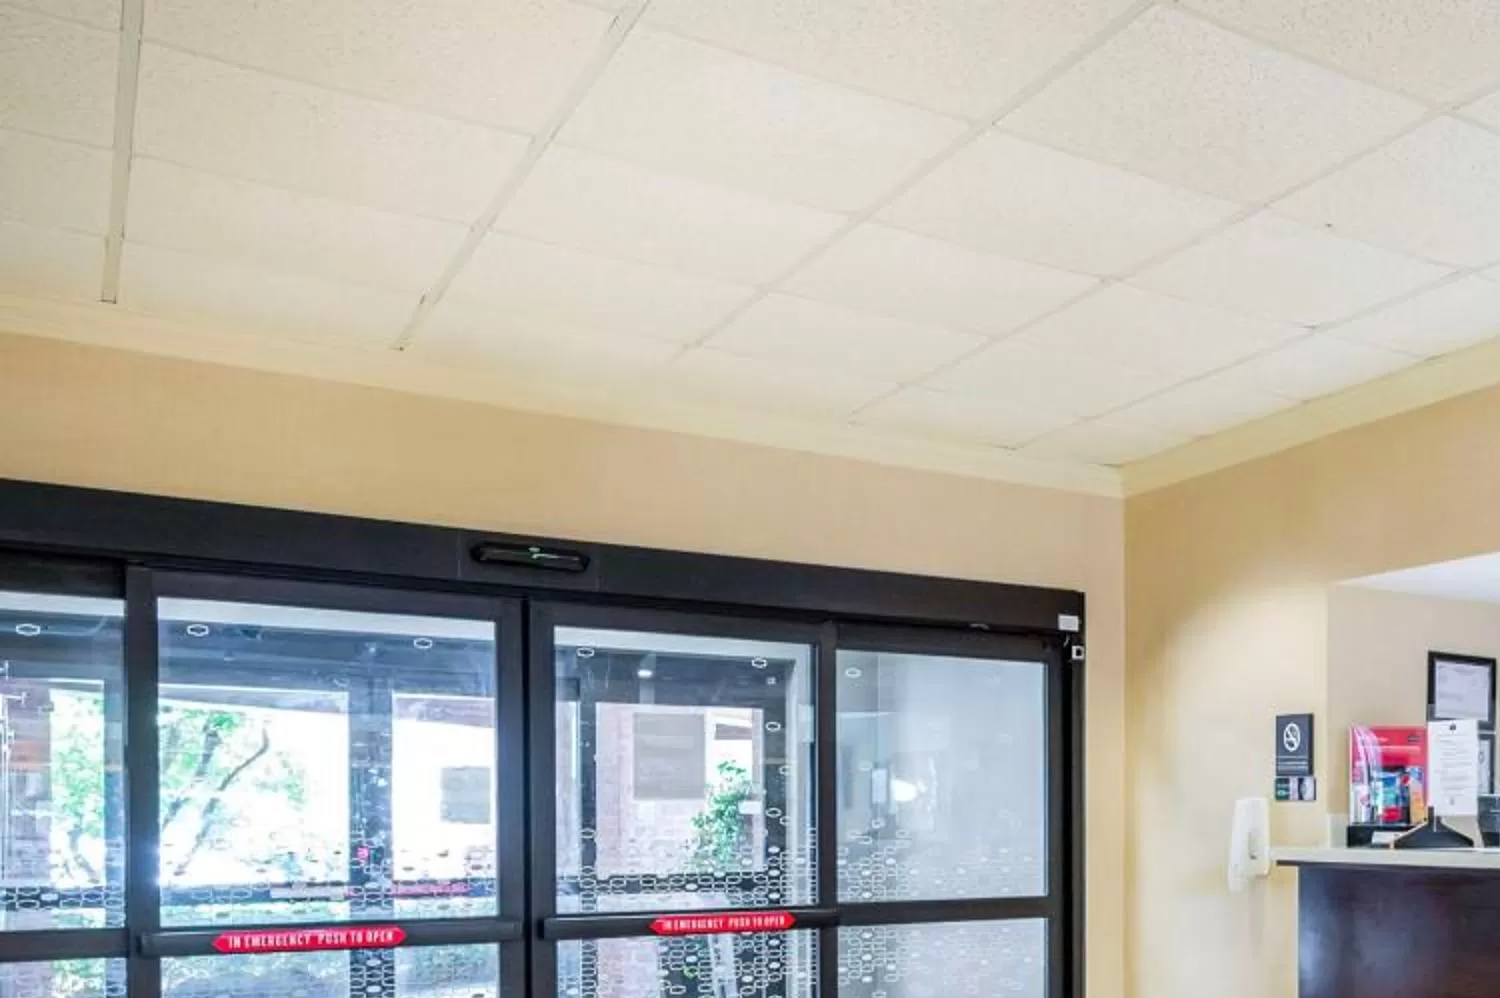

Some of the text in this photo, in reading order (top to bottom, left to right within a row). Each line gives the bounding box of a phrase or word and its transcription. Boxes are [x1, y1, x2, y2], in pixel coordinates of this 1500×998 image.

[228, 926, 394, 949] IN EMERGENCY PUSH TO OPEN
